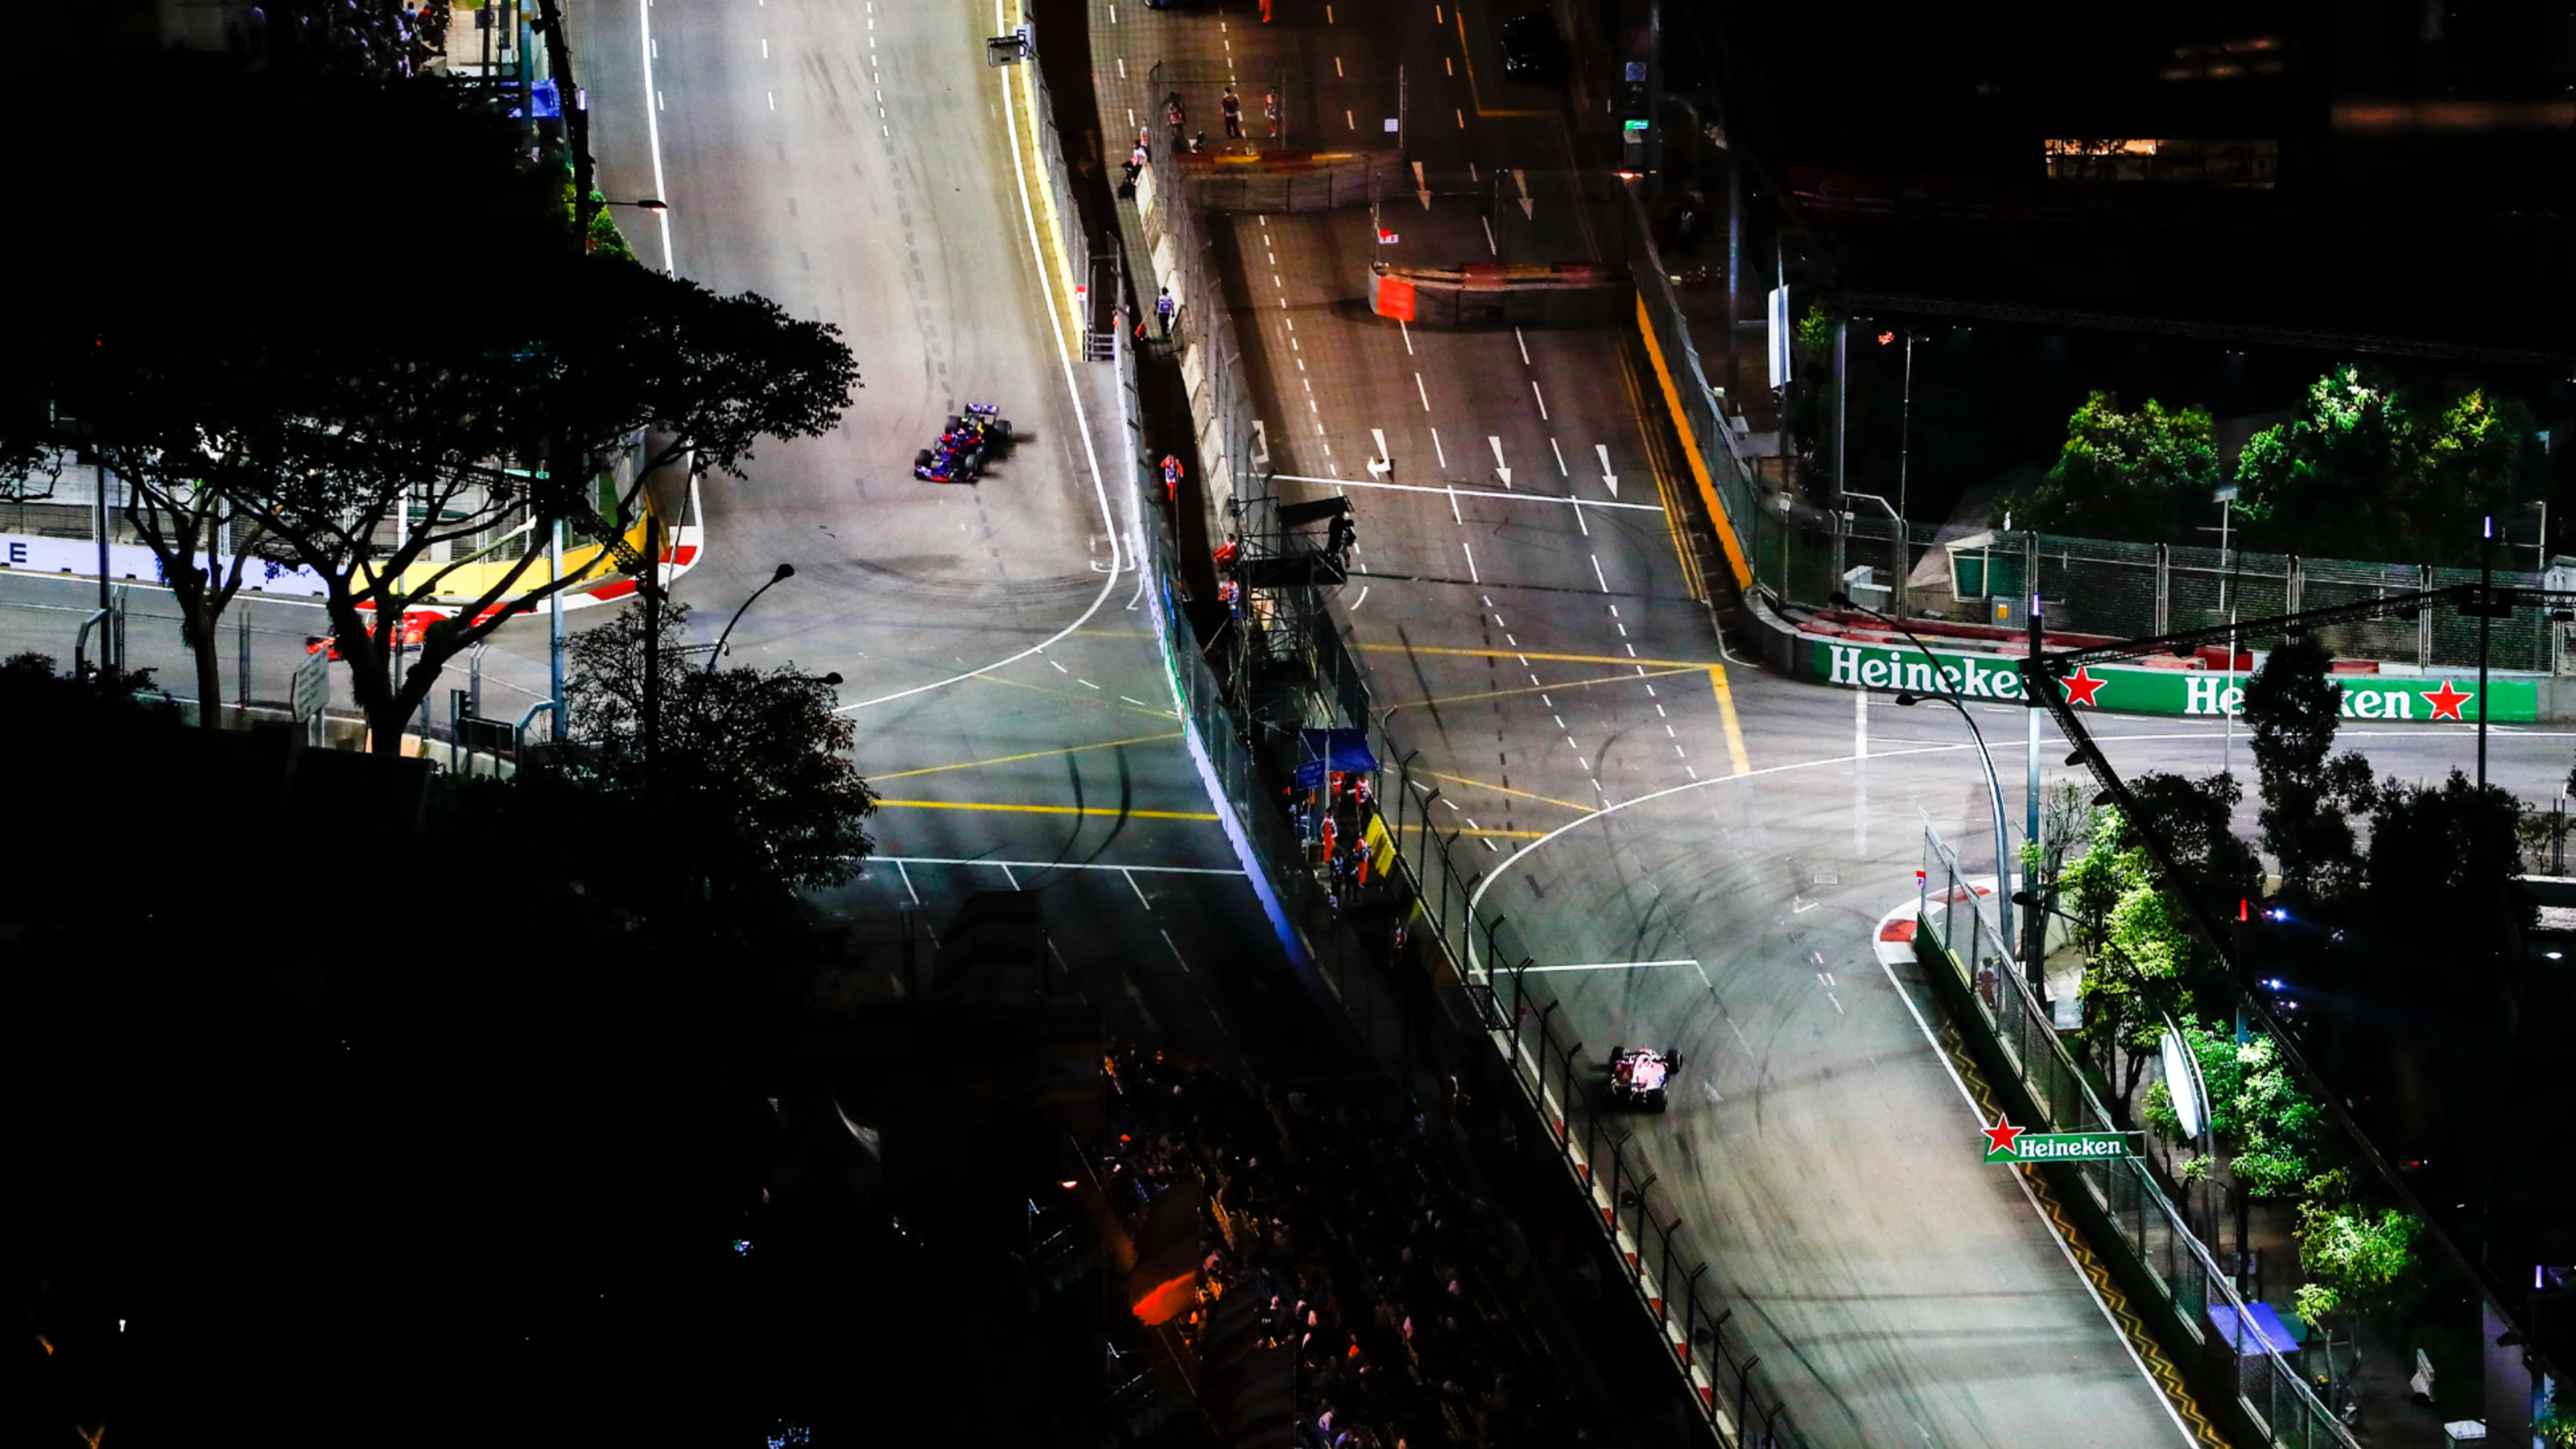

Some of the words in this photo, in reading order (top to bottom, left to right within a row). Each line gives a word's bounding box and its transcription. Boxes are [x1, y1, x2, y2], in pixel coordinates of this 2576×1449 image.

[1829, 645, 2030, 700] Heineke
[2184, 677, 2413, 719] Heken
[2019, 1137, 2122, 1158] Heineken
